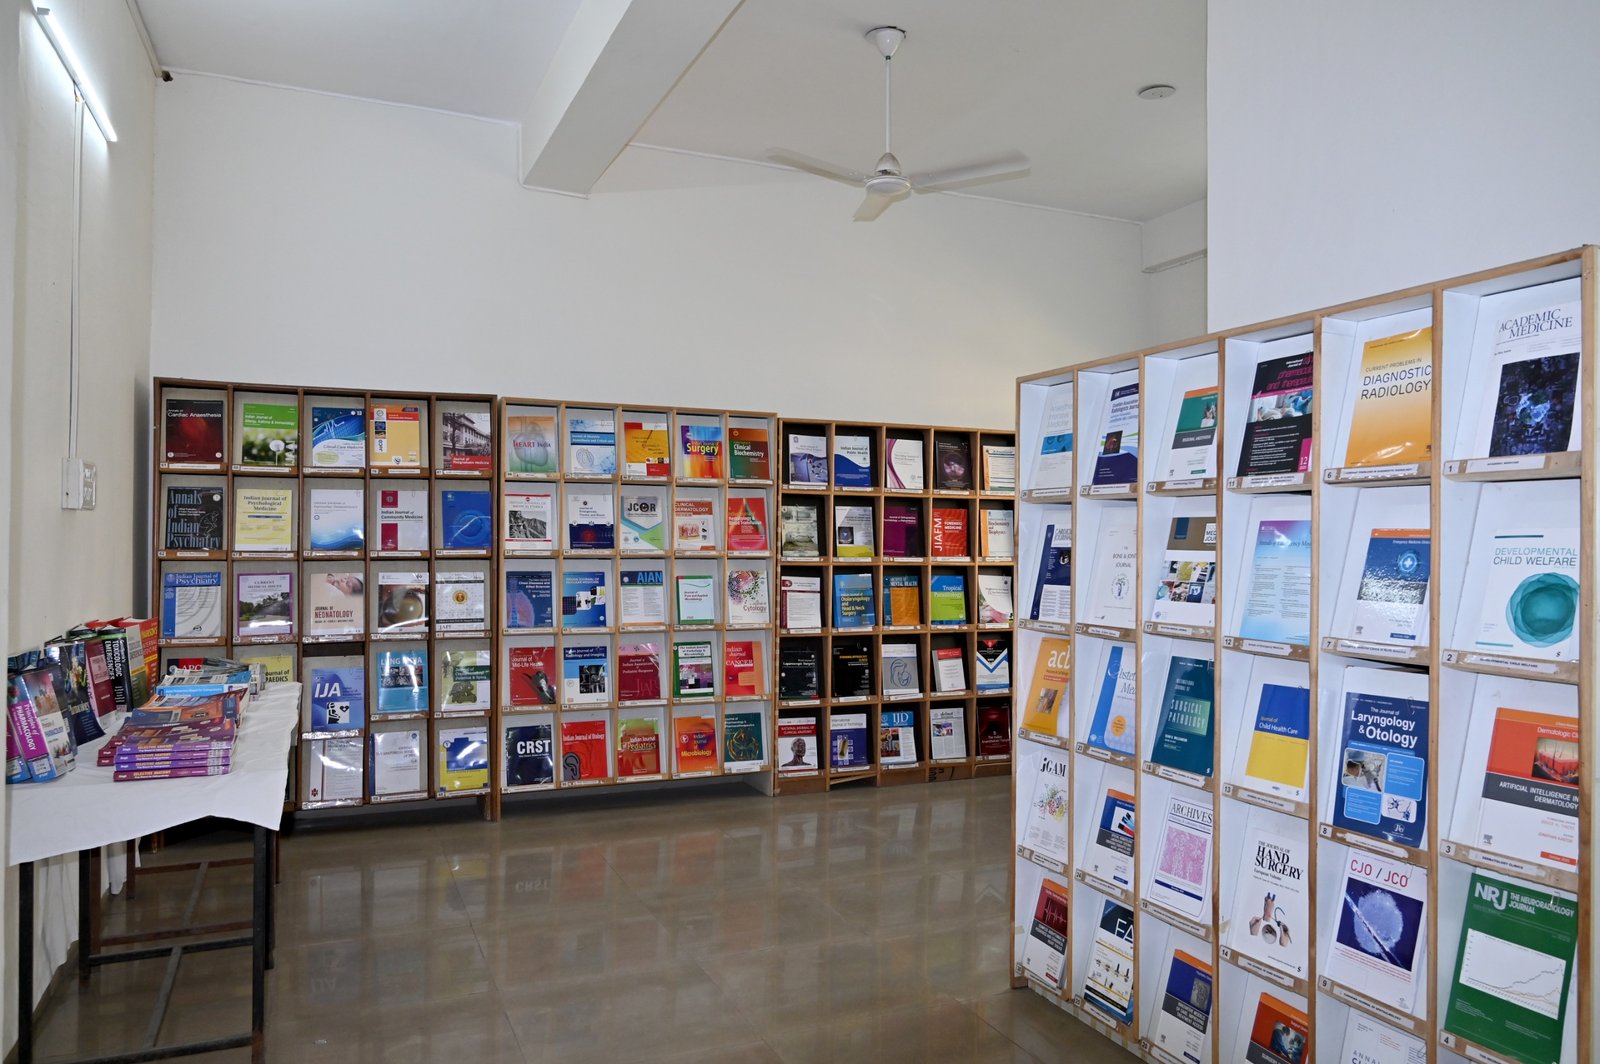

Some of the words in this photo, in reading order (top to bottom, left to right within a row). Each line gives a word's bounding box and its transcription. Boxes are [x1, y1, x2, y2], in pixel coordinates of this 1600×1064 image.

[1499, 308, 1561, 332] ACADEMIC
[1509, 316, 1573, 338] MEDICINE
[1365, 364, 1388, 372] CURRENT
[1390, 359, 1412, 368] PROBLEMS
[1363, 364, 1432, 386] DIAGNOSTIC
[1360, 378, 1432, 400] RADIOLOGY
[686, 442, 719, 455] Surgery
[734, 450, 764, 458] Biochemistry
[1300, 456, 1308, 466] 12
[1448, 464, 1452, 472] 1
[170, 490, 202, 505] Annals
[168, 505, 178, 518] of
[628, 502, 656, 512] JCOR
[168, 519, 199, 533] Indian
[166, 532, 221, 548] Psychiatry
[1494, 547, 1578, 556] DEVELOPMENTAL
[1493, 557, 1522, 565] CHILD
[1526, 557, 1577, 566] WELFARE
[637, 572, 662, 584] AIAN
[314, 610, 354, 619] NEONATOLOGY
[105, 640, 115, 680] EMERGENCIES
[113, 641, 122, 677] TOXICOLOGIC
[314, 682, 341, 698] IJA
[1170, 699, 1202, 714] SURGICAL
[893, 713, 908, 723] IJD
[1168, 712, 1206, 728] PATHOLOGY
[1351, 710, 1415, 732] Laryngology
[16, 705, 36, 751] PHARMACOLOGY
[1259, 722, 1271, 730] Child
[1272, 724, 1287, 733] Health
[1288, 727, 1298, 736] Care
[1537, 726, 1570, 738] Dermatologic
[1358, 725, 1365, 734] &
[1366, 725, 1418, 749] Otology
[517, 740, 551, 755] CRST
[627, 742, 656, 750] Pediatrics
[1499, 781, 1528, 793] ARTIFICIAL
[1530, 787, 1571, 800] INTELLIGENCE
[1534, 796, 1579, 810] DERMATOLOGY
[1170, 803, 1212, 824] ARCHIVES
[1267, 842, 1284, 852] JOURNAL
[1445, 845, 1451, 854] 3
[1257, 846, 1290, 864] HAND
[1254, 856, 1303, 880] SURGERY
[1350, 859, 1372, 876] CJO
[1376, 868, 1382, 879] /
[1384, 871, 1408, 888] JCO
[1474, 882, 1508, 910] NRJ
[1508, 901, 1536, 914] JOURNAL
[1510, 892, 1520, 901] THE
[1521, 894, 1575, 918] NEURORADIOLOGY
